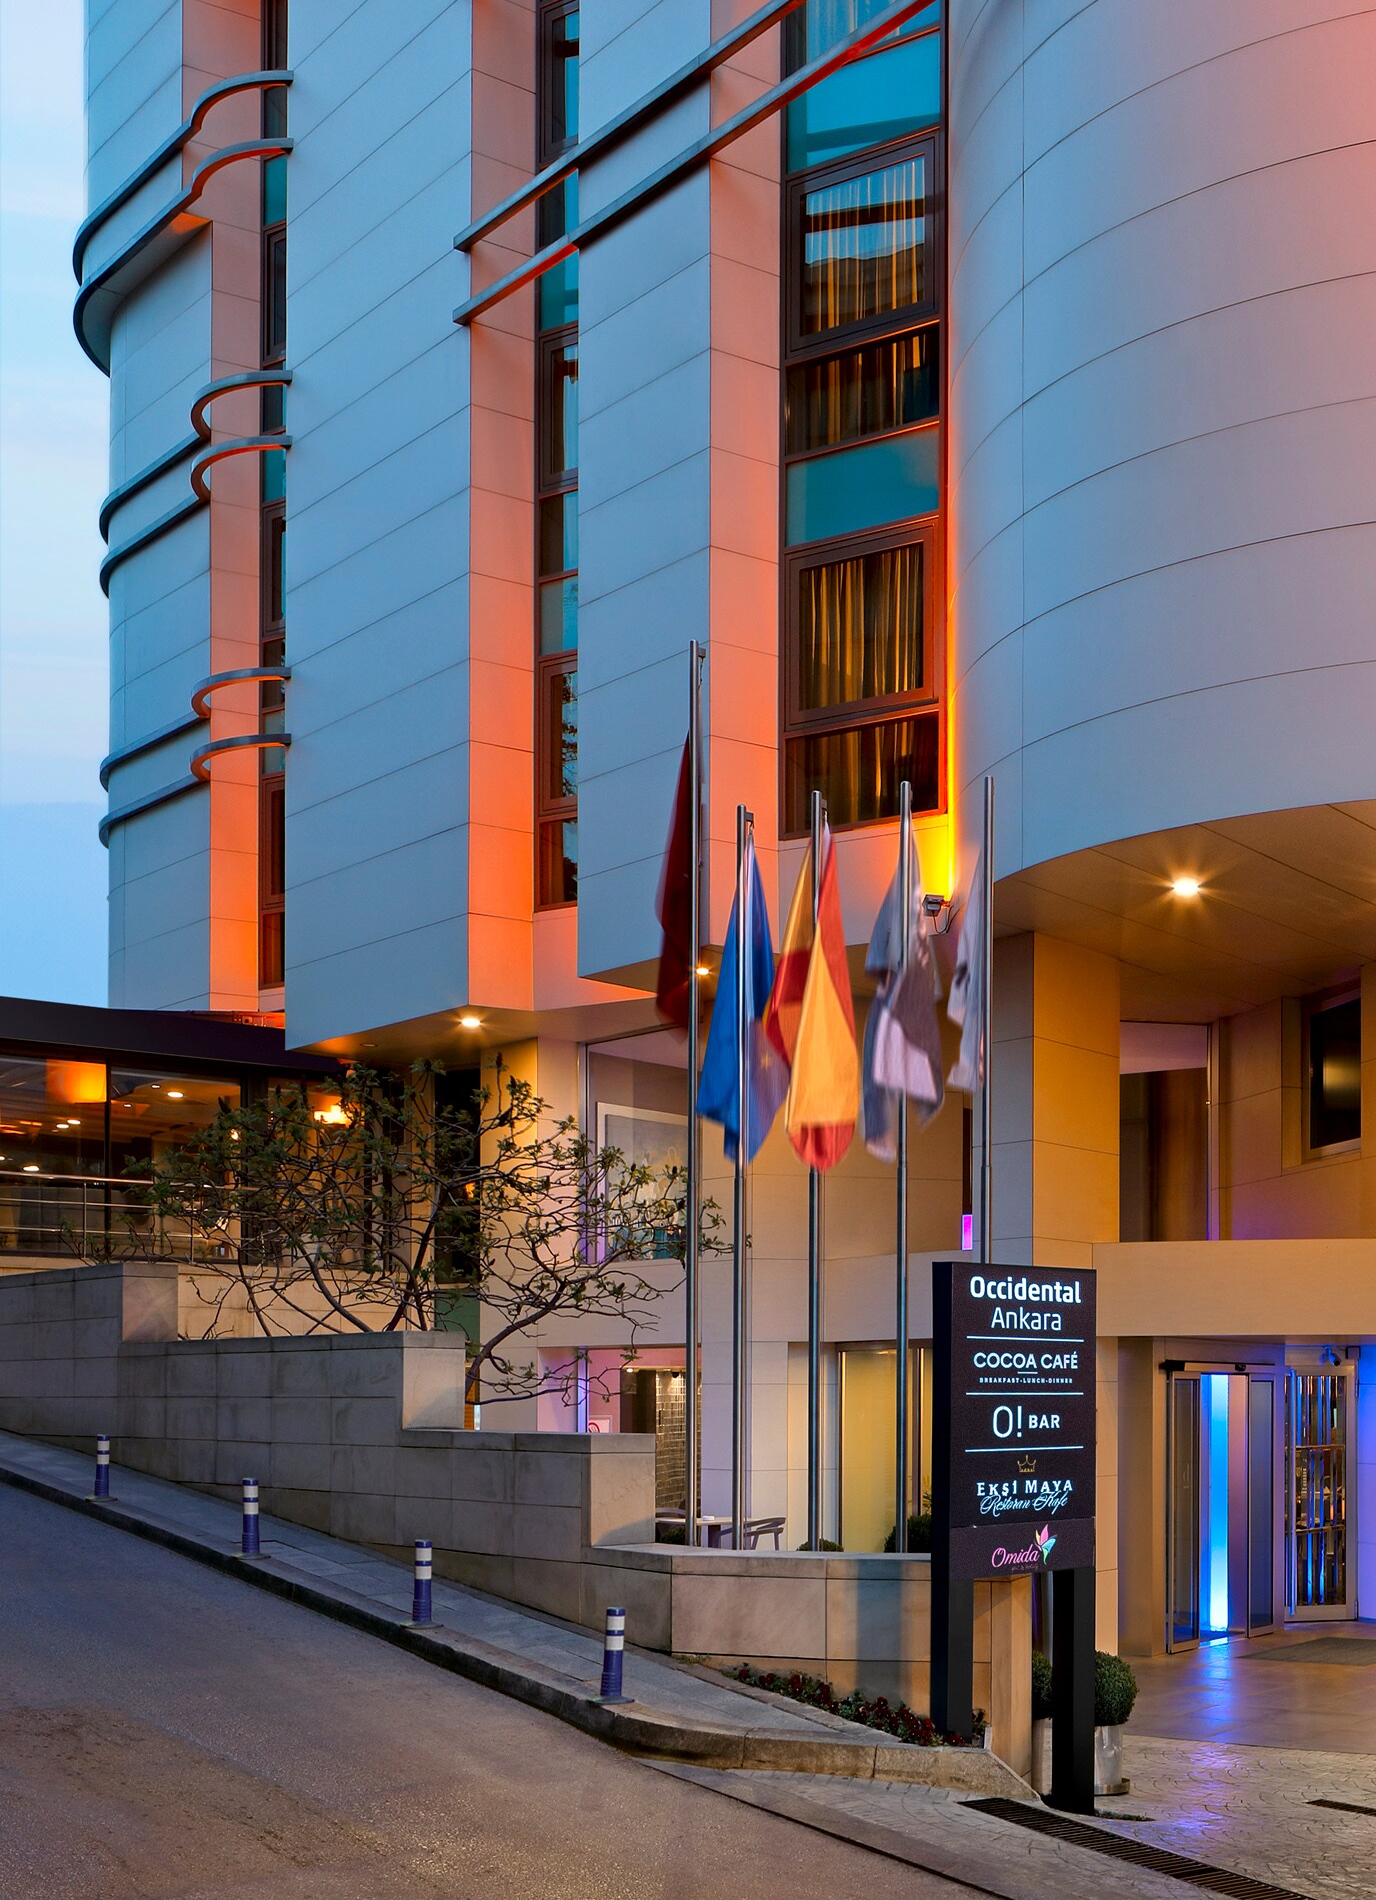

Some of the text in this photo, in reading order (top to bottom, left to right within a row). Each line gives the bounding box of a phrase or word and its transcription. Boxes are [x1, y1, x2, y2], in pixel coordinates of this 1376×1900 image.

[970, 1276, 1082, 1304] Occidental
[991, 1306, 1062, 1331] Ankara
[973, 1351, 1078, 1369] COCOA CAFÉ
[1028, 1414, 1060, 1429] BAR
[1025, 1480, 1073, 1494] MAYA
[991, 1544, 1040, 1568] Omida
